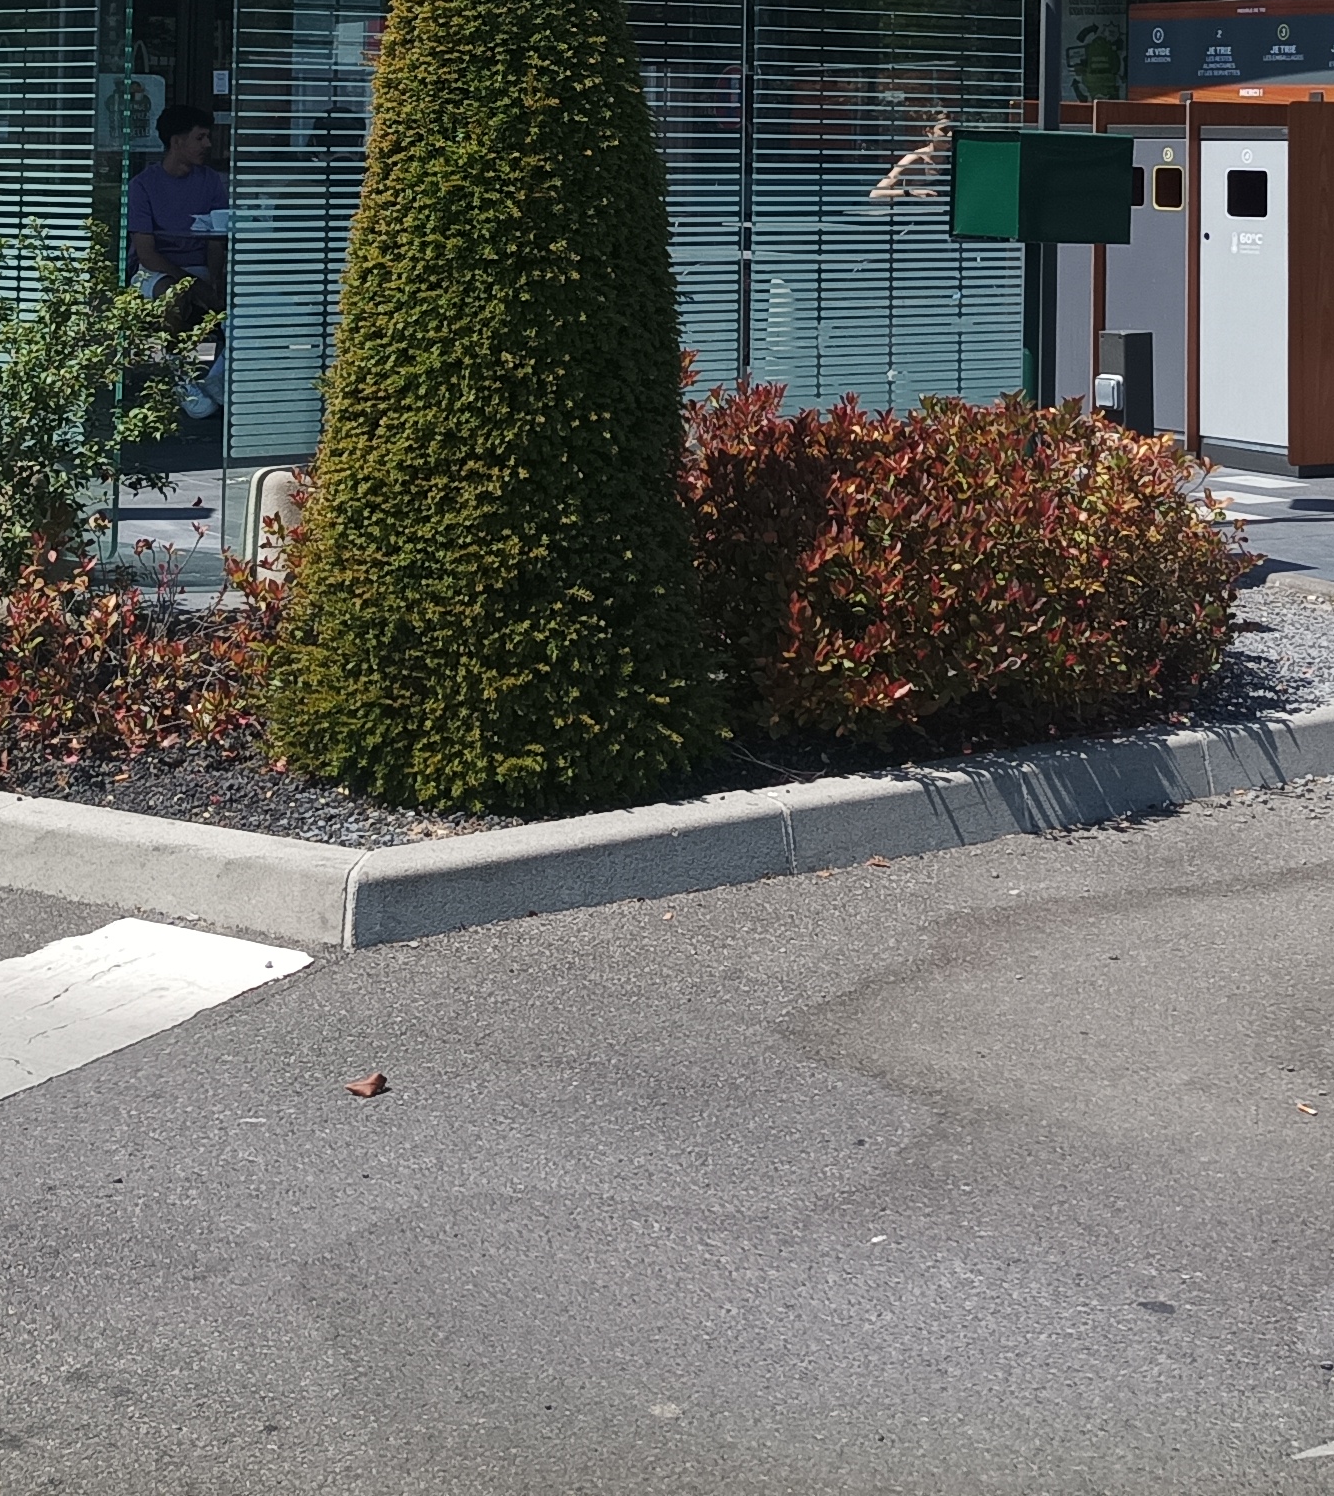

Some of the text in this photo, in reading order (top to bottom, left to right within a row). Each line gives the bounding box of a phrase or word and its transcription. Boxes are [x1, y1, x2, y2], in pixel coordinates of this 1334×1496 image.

[1216, 29, 1222, 38] 2
[1145, 47, 1171, 56] JE VIDE
[1206, 46, 1232, 55] JE TRIE
[1270, 44, 1297, 54] JE TRIE
[1239, 232, 1263, 245] 60°C
